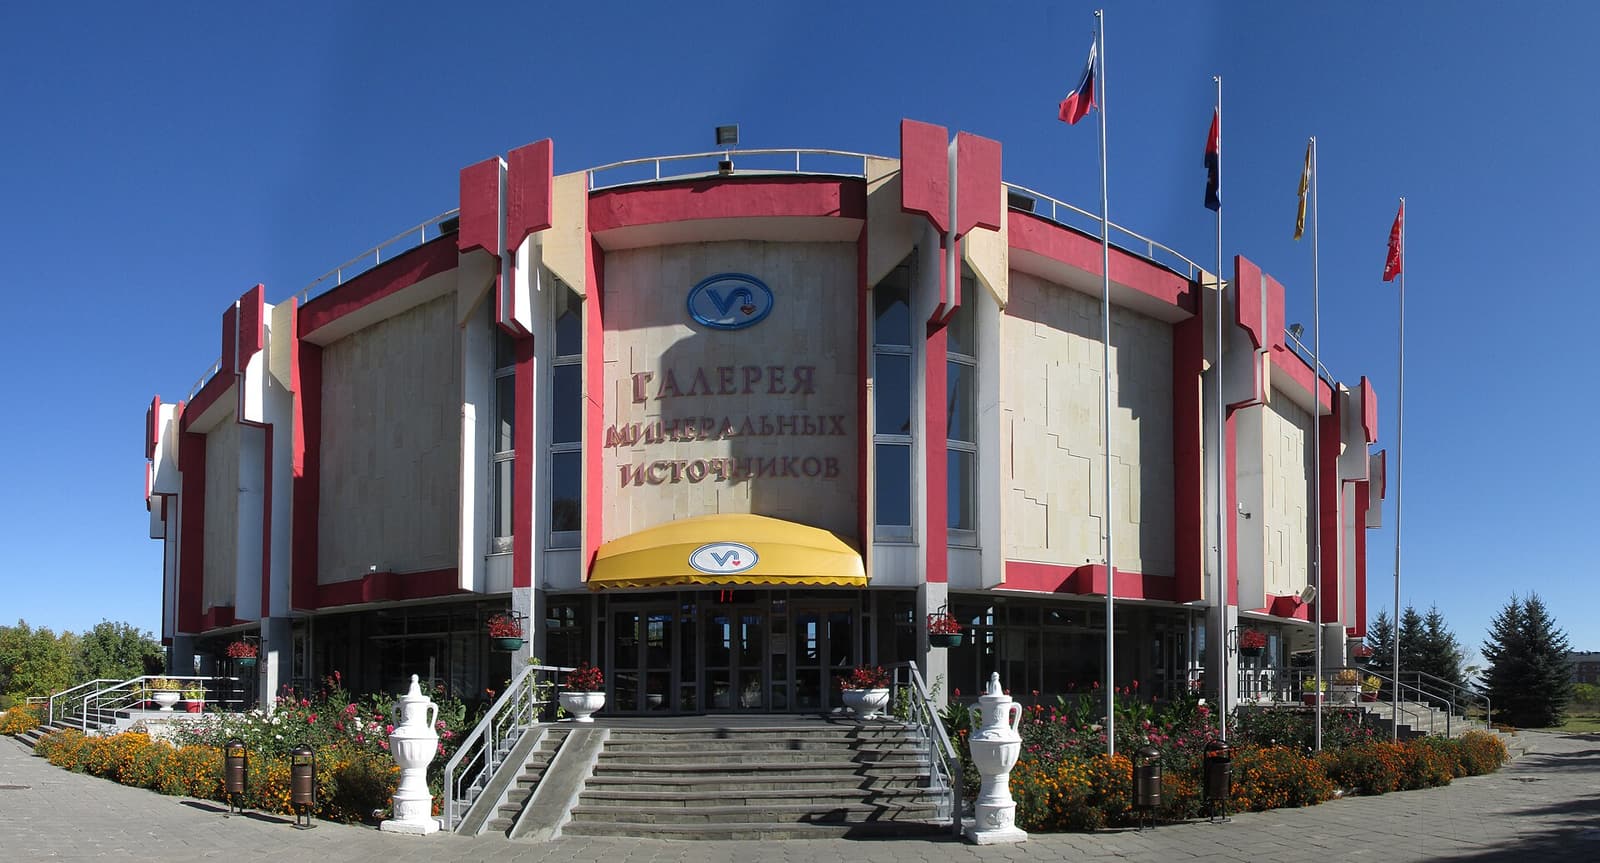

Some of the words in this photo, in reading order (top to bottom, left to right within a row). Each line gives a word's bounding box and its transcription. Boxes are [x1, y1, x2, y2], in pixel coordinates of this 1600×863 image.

[631, 366, 817, 403] ГАЛЕРЕЯ
[604, 415, 848, 448] МИНЕРАЛЬНЫХ
[617, 456, 841, 488] ИСТОЧНИКОВ
